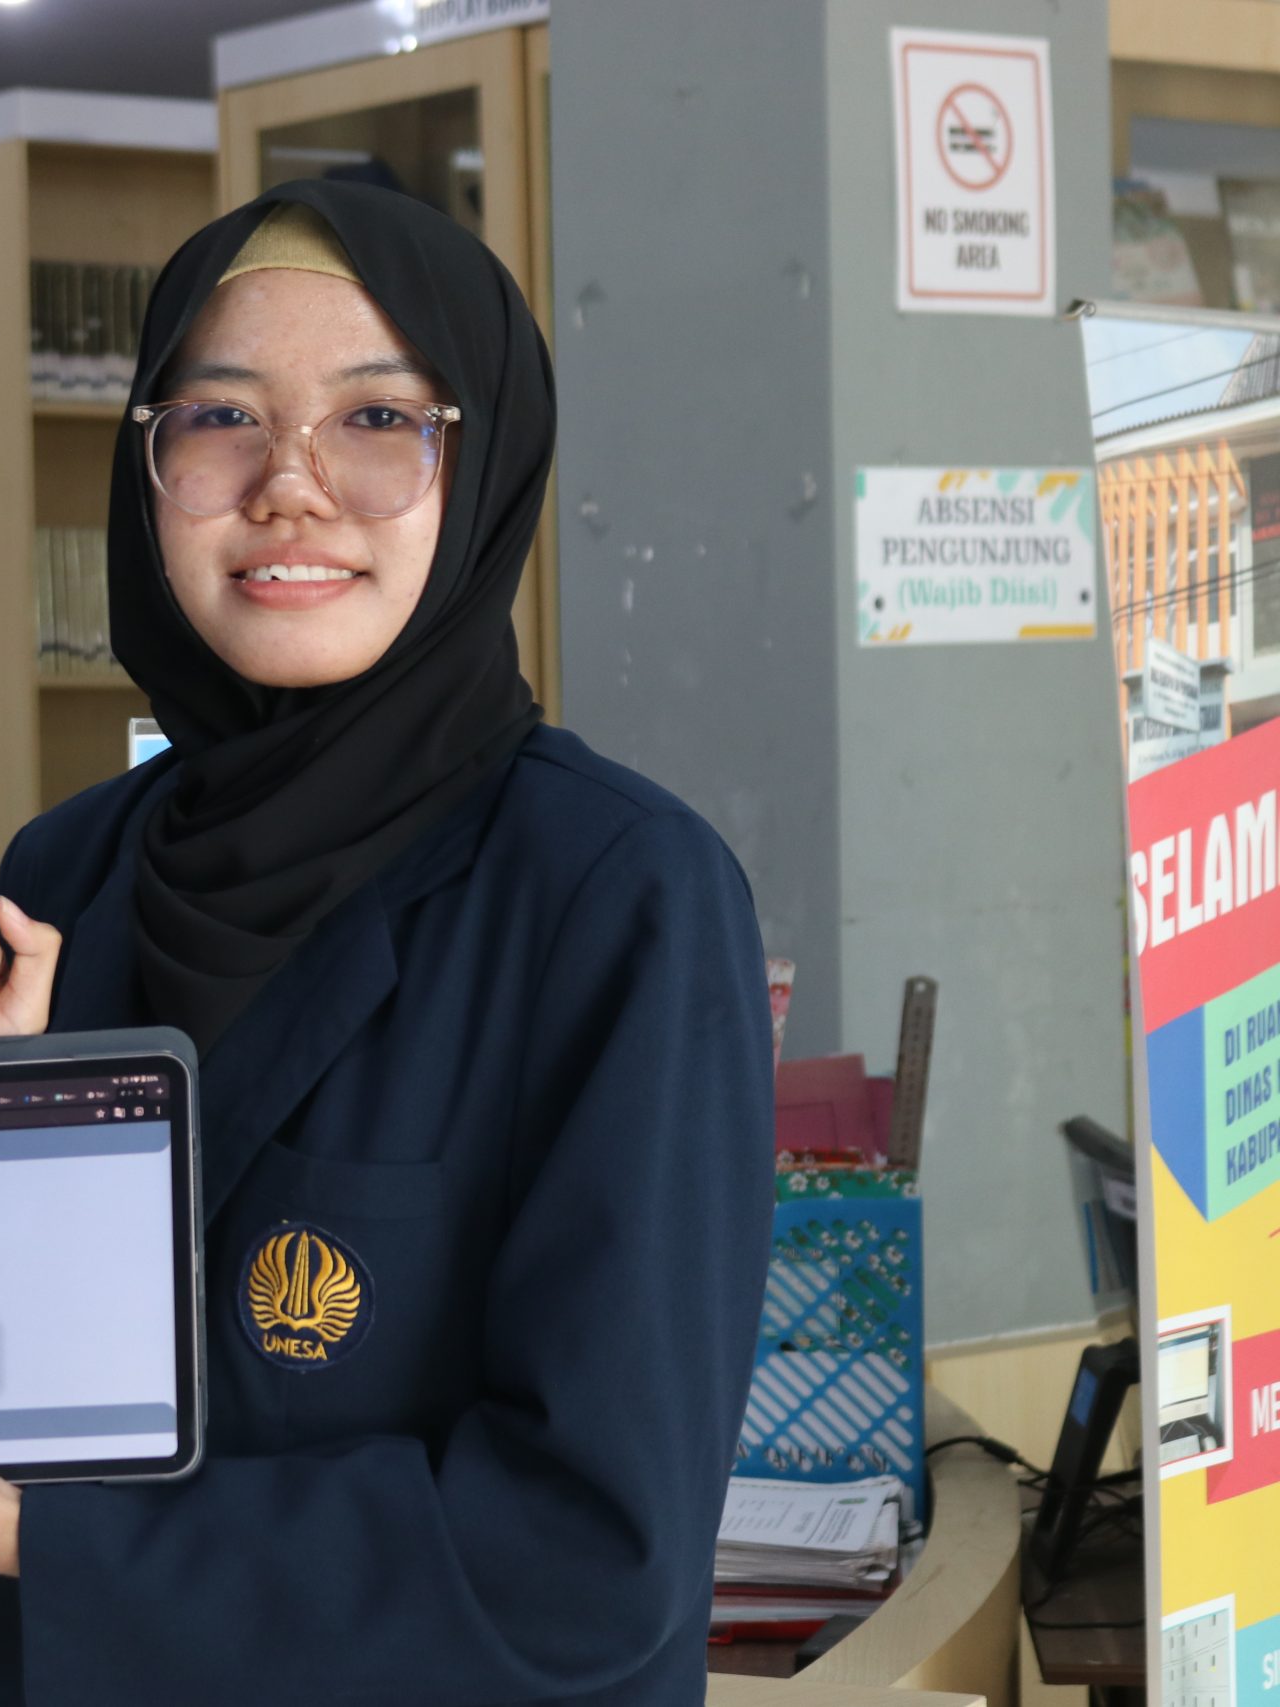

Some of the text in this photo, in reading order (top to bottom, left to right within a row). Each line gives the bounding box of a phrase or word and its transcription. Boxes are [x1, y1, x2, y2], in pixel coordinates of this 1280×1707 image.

[924, 207, 1030, 238] NO SMOKING
[956, 244, 1001, 270] AREA
[918, 497, 1035, 526] ABSENSI
[881, 536, 1072, 567] PENGUNJUNG
[897, 576, 1058, 612] (Wajib Diisi)
[1130, 789, 1280, 958] SELAM
[1224, 1022, 1241, 1068] DI
[1225, 1065, 1272, 1128] DINAS
[264, 1333, 328, 1360] UNESA
